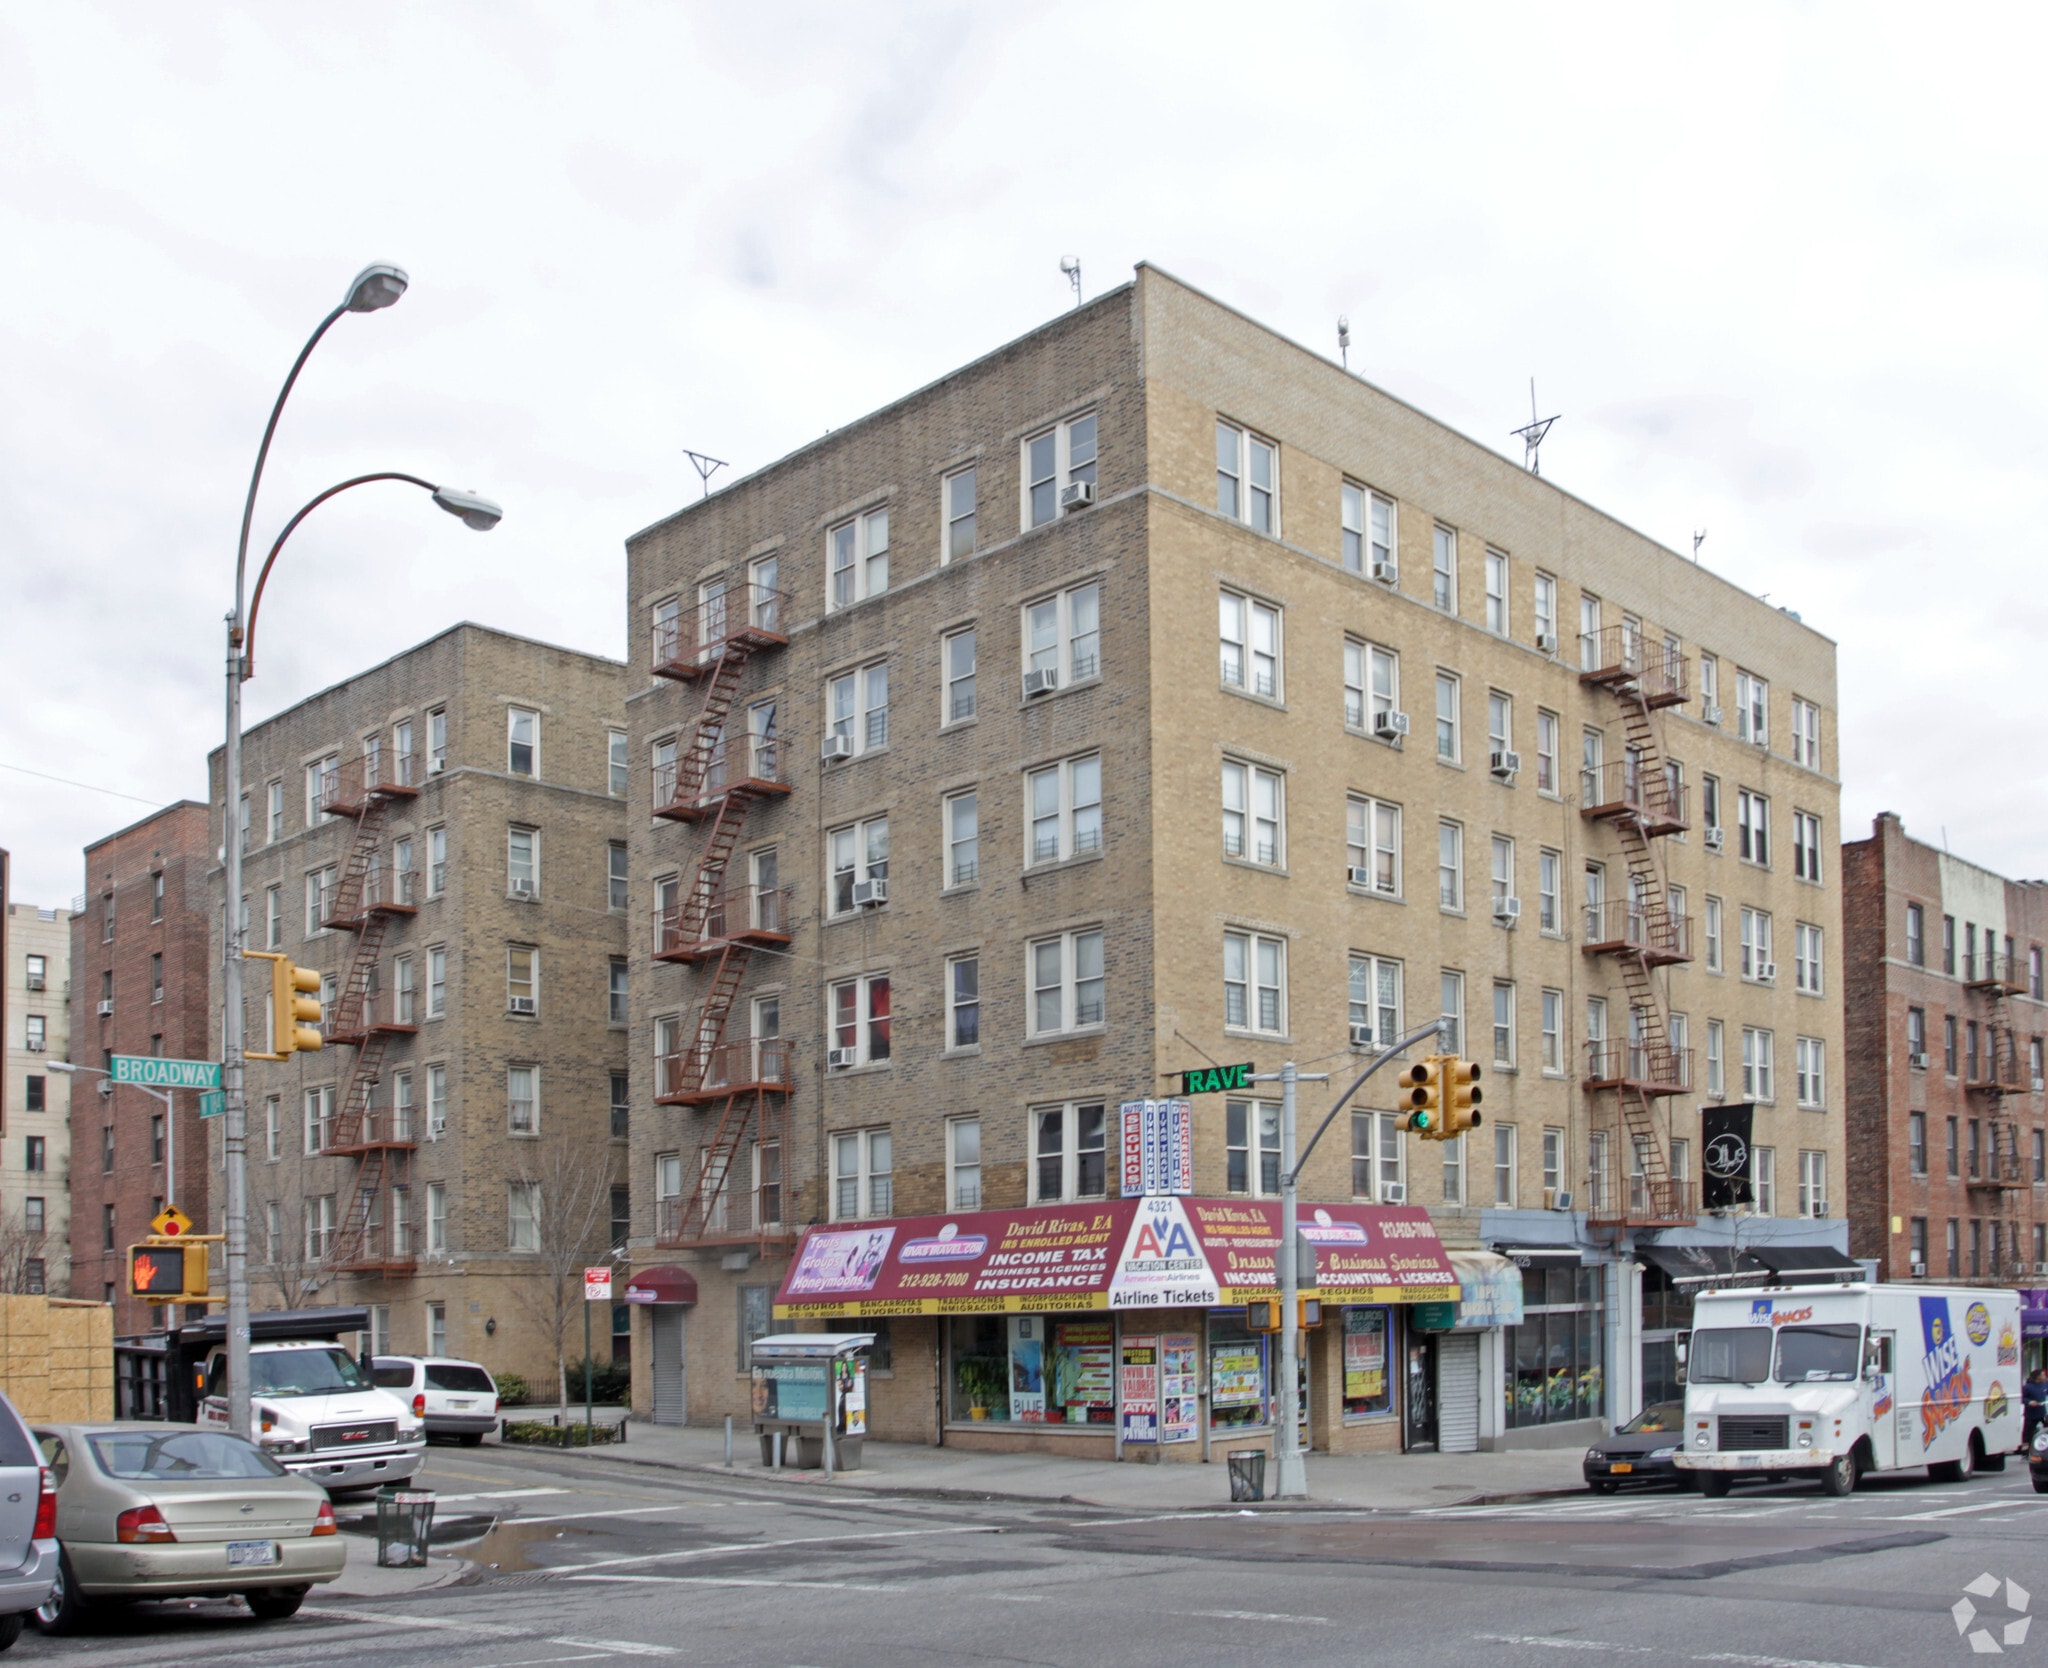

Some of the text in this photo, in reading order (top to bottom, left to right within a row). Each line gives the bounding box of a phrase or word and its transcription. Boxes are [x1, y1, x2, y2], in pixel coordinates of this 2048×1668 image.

[116, 1059, 217, 1085] BROADWAY
[1126, 1113, 1140, 1184] SEGUROS
[1172, 1105, 1181, 1189] DIVORCIOS
[1123, 1184, 1143, 1193] TAXI
[1147, 1201, 1173, 1212] 4321
[1005, 1215, 1113, 1237] David Rivas, EA
[811, 1237, 841, 1249] Tours
[1000, 1233, 1112, 1250] IRS ENROLLED AGENT
[987, 1247, 1109, 1266] INCOME TAX
[1228, 1251, 1440, 1271] Insur Business Services
[801, 1257, 842, 1272] Groups
[980, 1263, 1107, 1277] BUSINESS LICENCES
[1125, 1259, 1203, 1272] VACATION CENTER
[792, 1275, 865, 1291] Honeymoons
[898, 1272, 970, 1288] 212-928-7000
[974, 1274, 1103, 1290] INSURANCE
[1223, 1272, 1277, 1285] INCOME
[1400, 1272, 1454, 1284] LICENCES
[1112, 1290, 1215, 1305] Airline Tickets
[1232, 1288, 1281, 1296] BANCARRO
[1319, 1287, 1374, 1295] SEGUROS
[788, 1302, 845, 1312] SEGUROS
[859, 1299, 922, 1308] BANCARROTAS
[938, 1296, 1005, 1305] TRADUCCIONES
[1020, 1301, 1093, 1311] AUDITORIAS
[860, 1307, 922, 1316] DIVORCIOS
[1771, 1306, 1813, 1326] SNACKS
[1922, 1334, 1960, 1390] WISE
[1123, 1379, 1156, 1392] VALORES
[1124, 1403, 1156, 1413] ATM
[1921, 1354, 1972, 1453] SNACKS
[341, 1431, 369, 1441] GMC
[1124, 1427, 1157, 1440] PAYMENT
